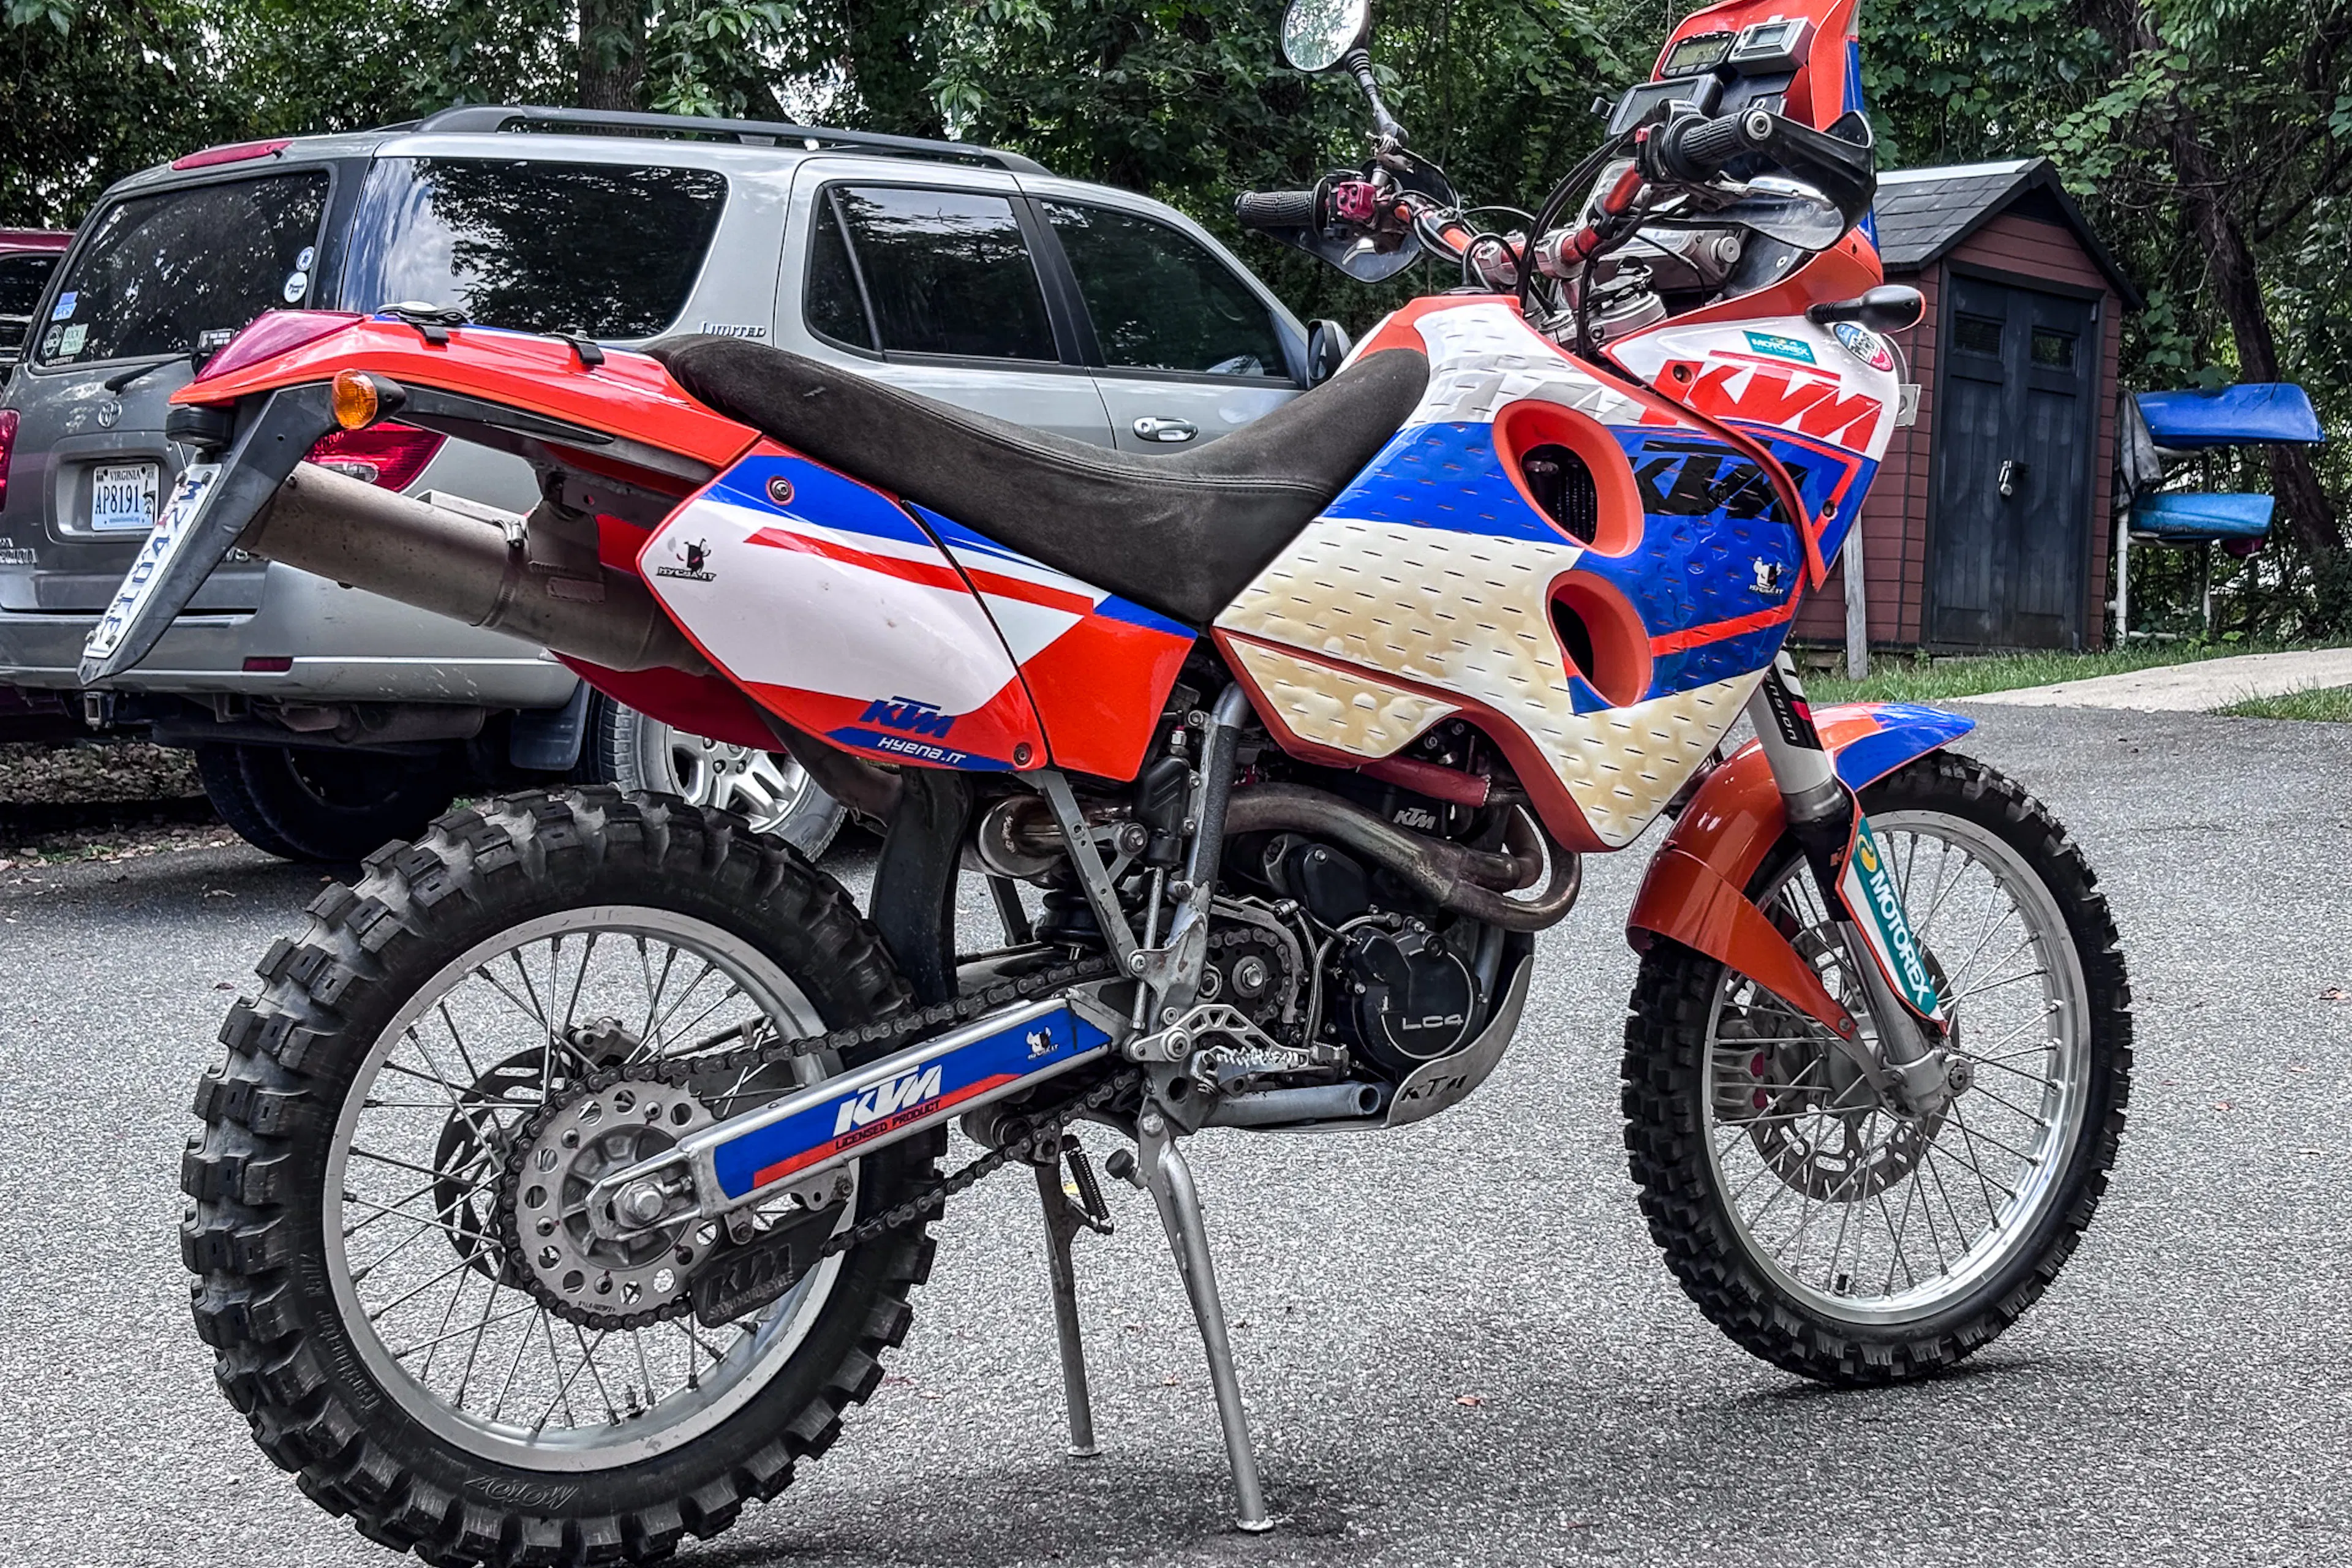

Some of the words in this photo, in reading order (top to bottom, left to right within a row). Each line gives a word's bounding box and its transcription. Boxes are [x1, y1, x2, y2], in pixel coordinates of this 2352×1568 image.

[1751, 338, 1810, 356] MOTOREX
[1640, 350, 1883, 453] KTM
[110, 469, 141, 481] VIRGINIA
[1628, 441, 1809, 526] KTM
[95, 484, 139, 514] AP8191
[859, 696, 956, 739] KTM
[1393, 807, 1436, 830] KTM
[1869, 869, 1931, 1006] MOTOREX
[1401, 1013, 1464, 1031] LC4
[833, 1064, 943, 1137] KTM
[1400, 1074, 1468, 1102] KTM
[835, 1120, 888, 1151] LICENSED
[892, 1099, 941, 1127] PRODUCT
[706, 1243, 793, 1310] KTM
